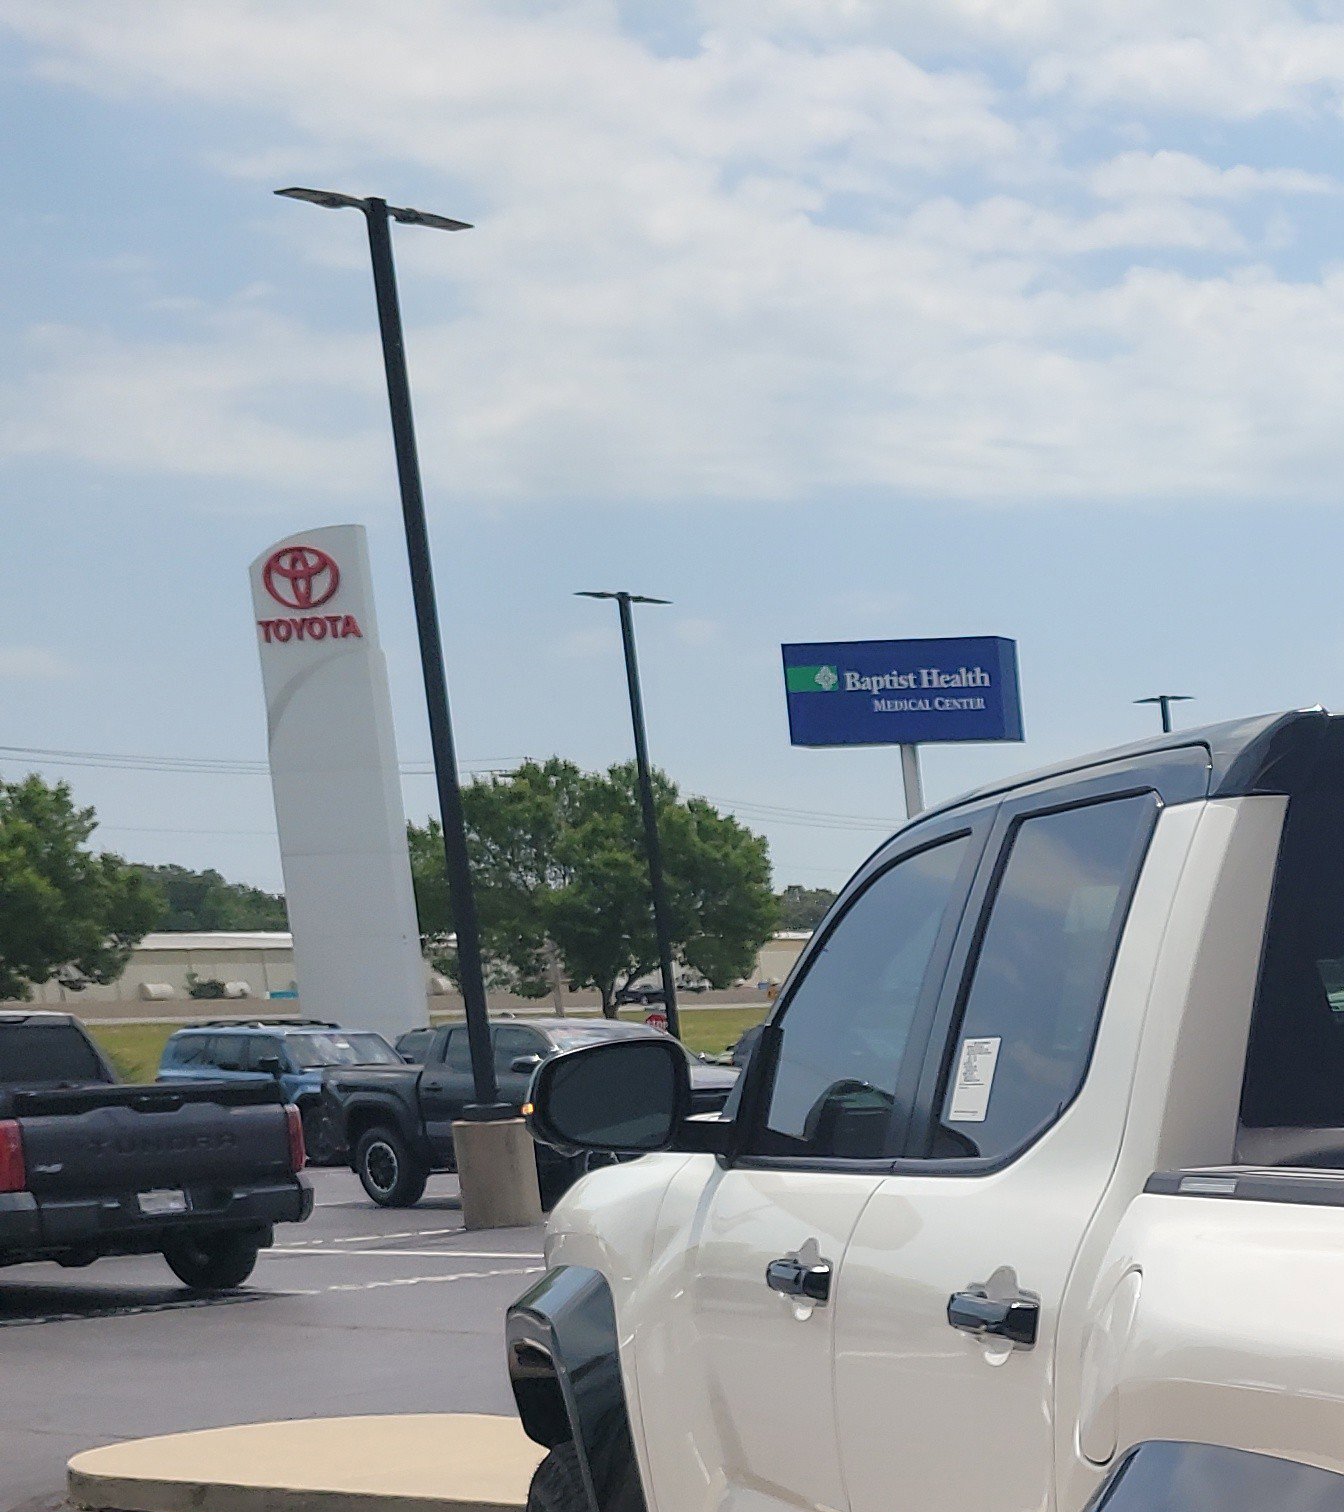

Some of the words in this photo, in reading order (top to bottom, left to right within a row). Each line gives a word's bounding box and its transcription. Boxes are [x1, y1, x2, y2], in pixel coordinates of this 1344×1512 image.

[257, 615, 363, 643] TOYOTA
[844, 669, 917, 695] Baptist
[919, 667, 991, 689] Health
[874, 696, 931, 712] MEDICAL
[934, 696, 986, 711] CENTER
